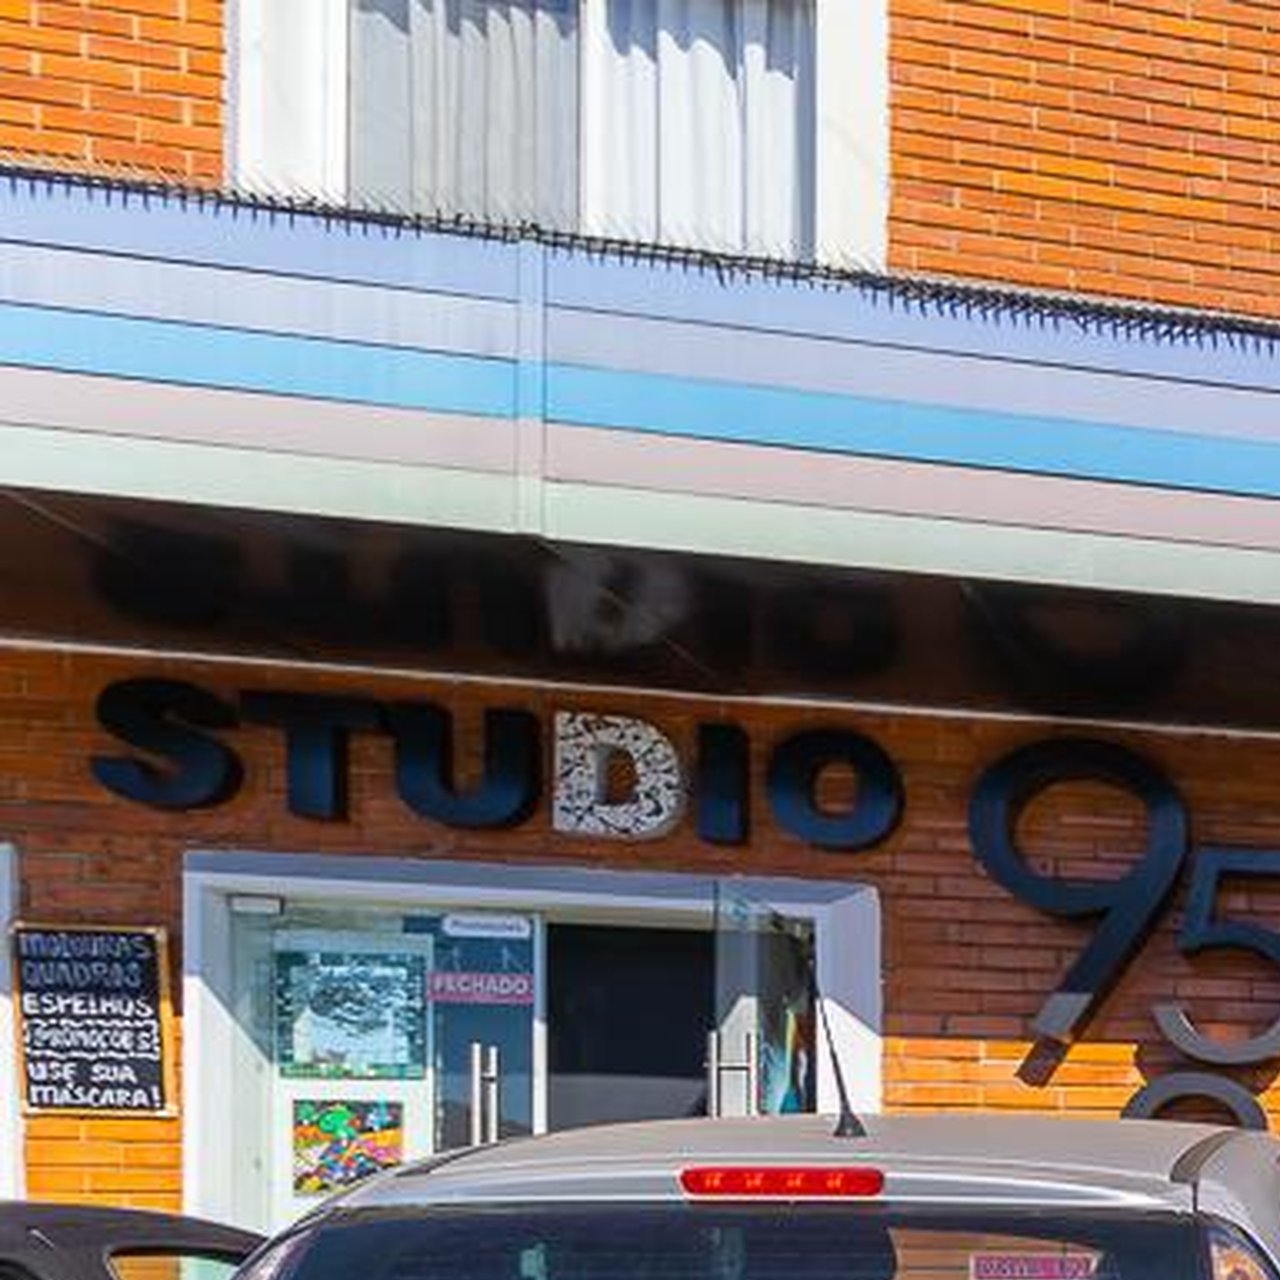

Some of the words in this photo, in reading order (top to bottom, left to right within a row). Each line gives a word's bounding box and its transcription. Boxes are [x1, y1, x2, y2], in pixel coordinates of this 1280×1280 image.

[88, 676, 905, 850] STUDIO
[432, 974, 529, 995] FECHADO
[22, 992, 154, 1017] ESPELHOS
[27, 1062, 77, 1082] USE
[91, 1062, 138, 1083] SUA
